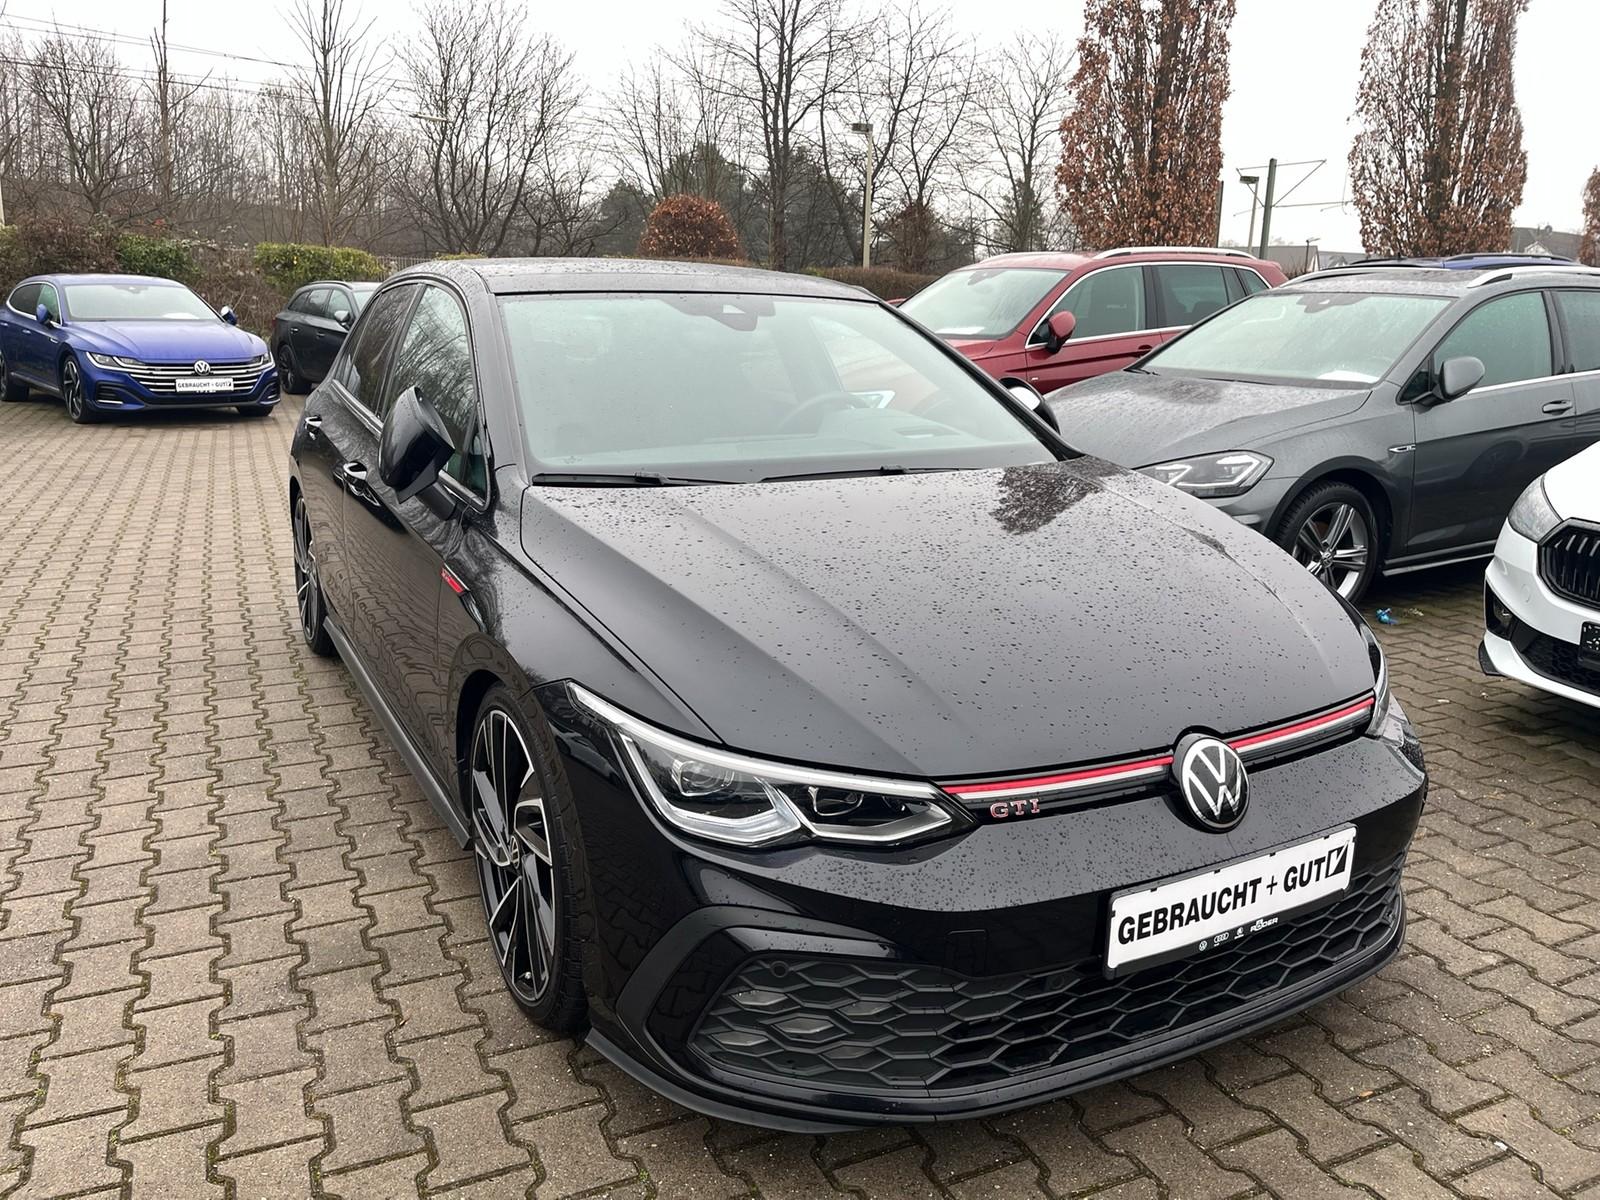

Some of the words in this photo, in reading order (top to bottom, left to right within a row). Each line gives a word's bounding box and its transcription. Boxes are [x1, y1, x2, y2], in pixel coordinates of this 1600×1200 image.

[990, 798, 1040, 818] GTI
[1118, 876, 1262, 945] GEBRAUCHT
[1266, 875, 1278, 896] +
[1283, 857, 1326, 893] GUT
